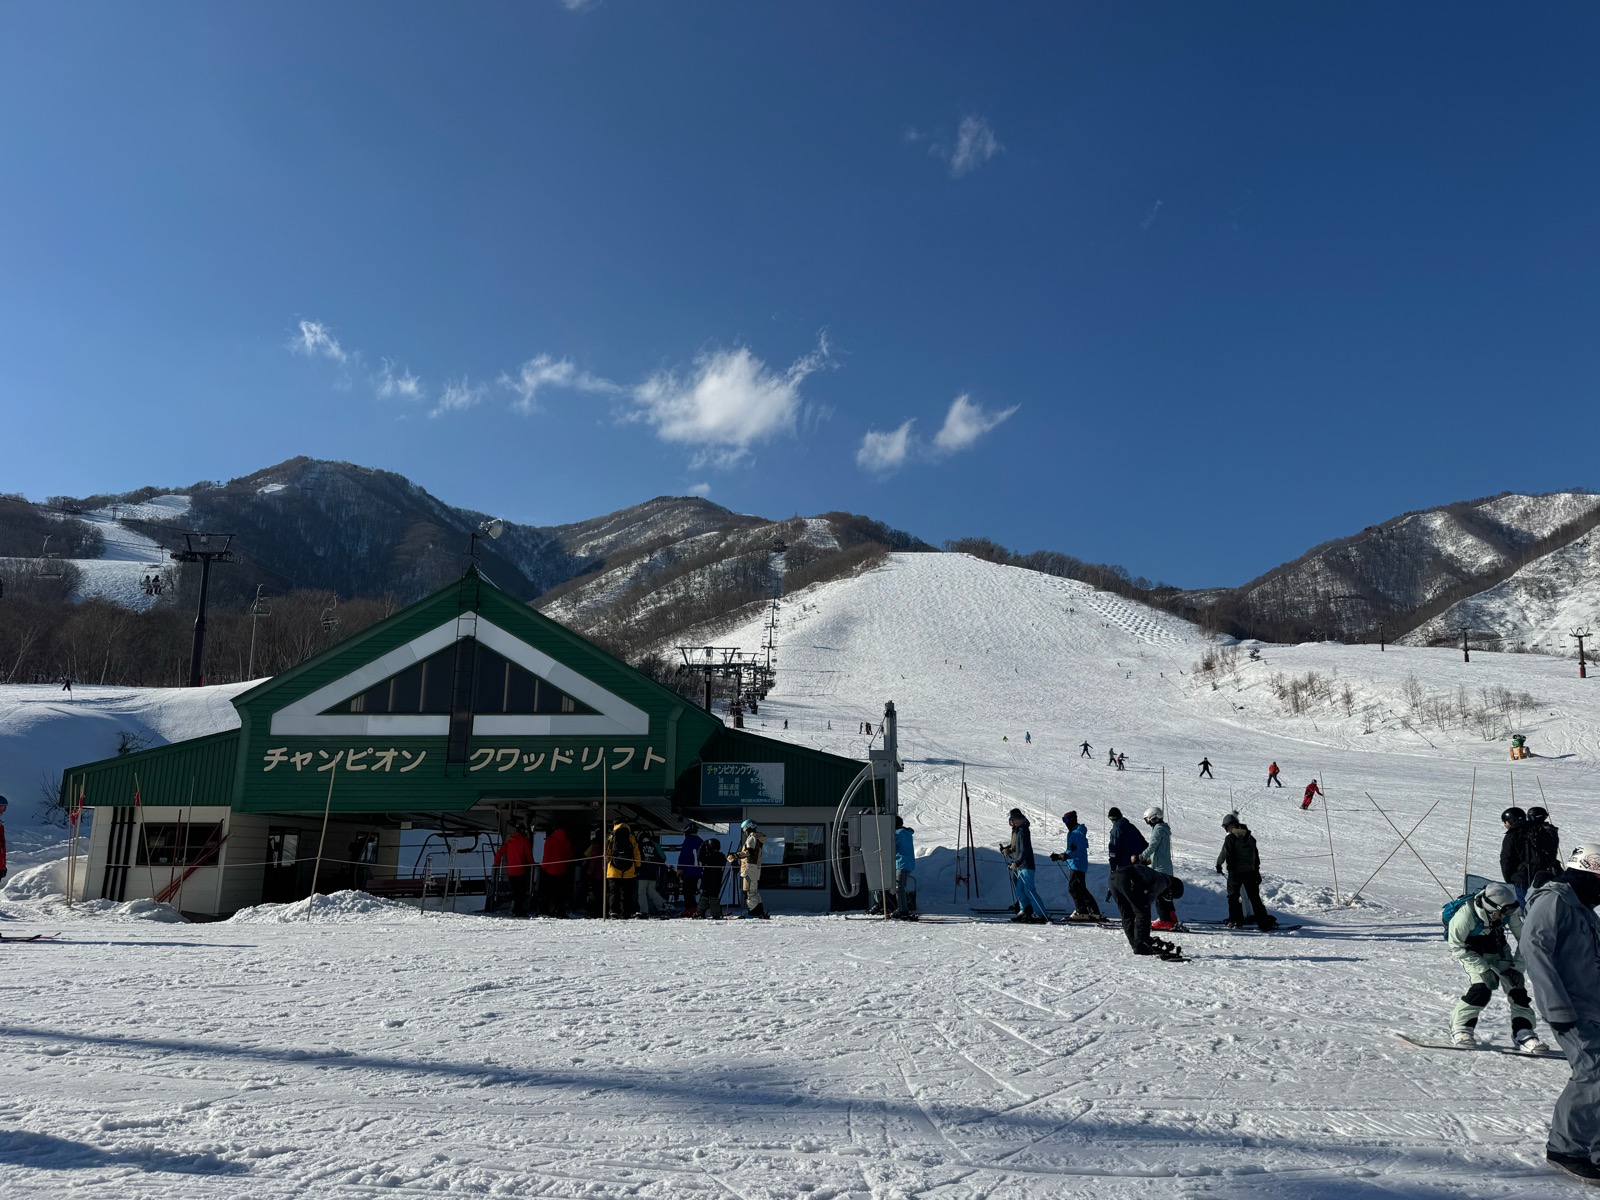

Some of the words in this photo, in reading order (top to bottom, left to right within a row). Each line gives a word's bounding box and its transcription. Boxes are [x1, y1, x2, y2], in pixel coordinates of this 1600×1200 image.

[263, 747, 427, 773] チャンピオン
[469, 746, 666, 772] クワッドリフト
[706, 765, 762, 775] チャンピオンクワッ
